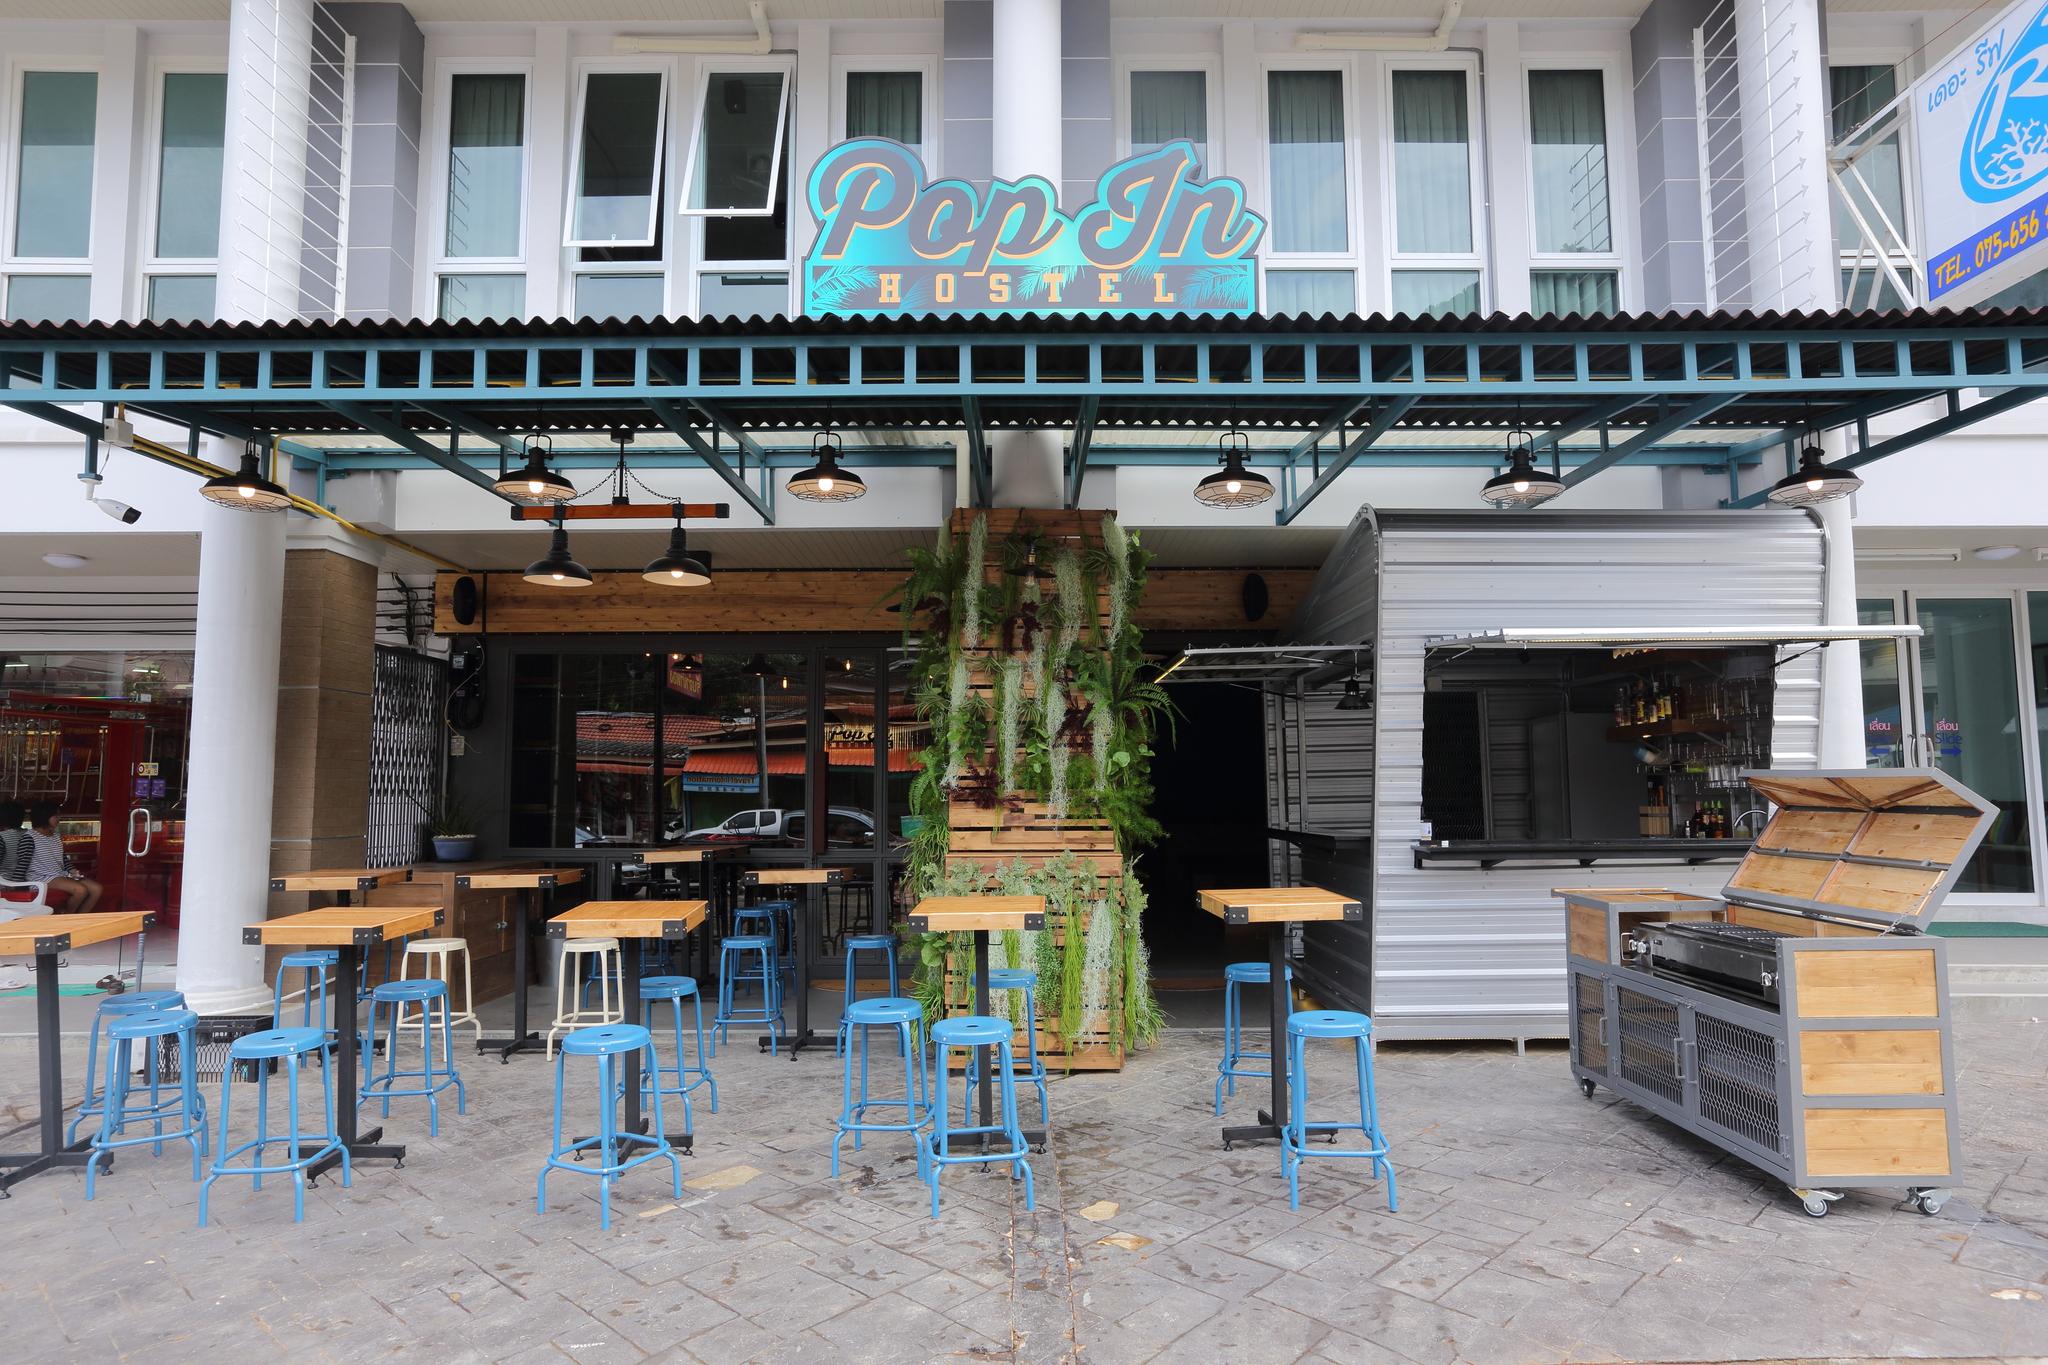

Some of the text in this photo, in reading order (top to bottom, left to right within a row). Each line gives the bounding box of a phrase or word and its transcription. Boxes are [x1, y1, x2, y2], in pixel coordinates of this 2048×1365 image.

[1927, 68, 1967, 113] เดอะ
[818, 146, 1257, 277] Pop In
[1935, 253, 1971, 289] TEL.
[1975, 209, 2040, 268] 075-656
[877, 272, 1176, 304] HOSTEL
